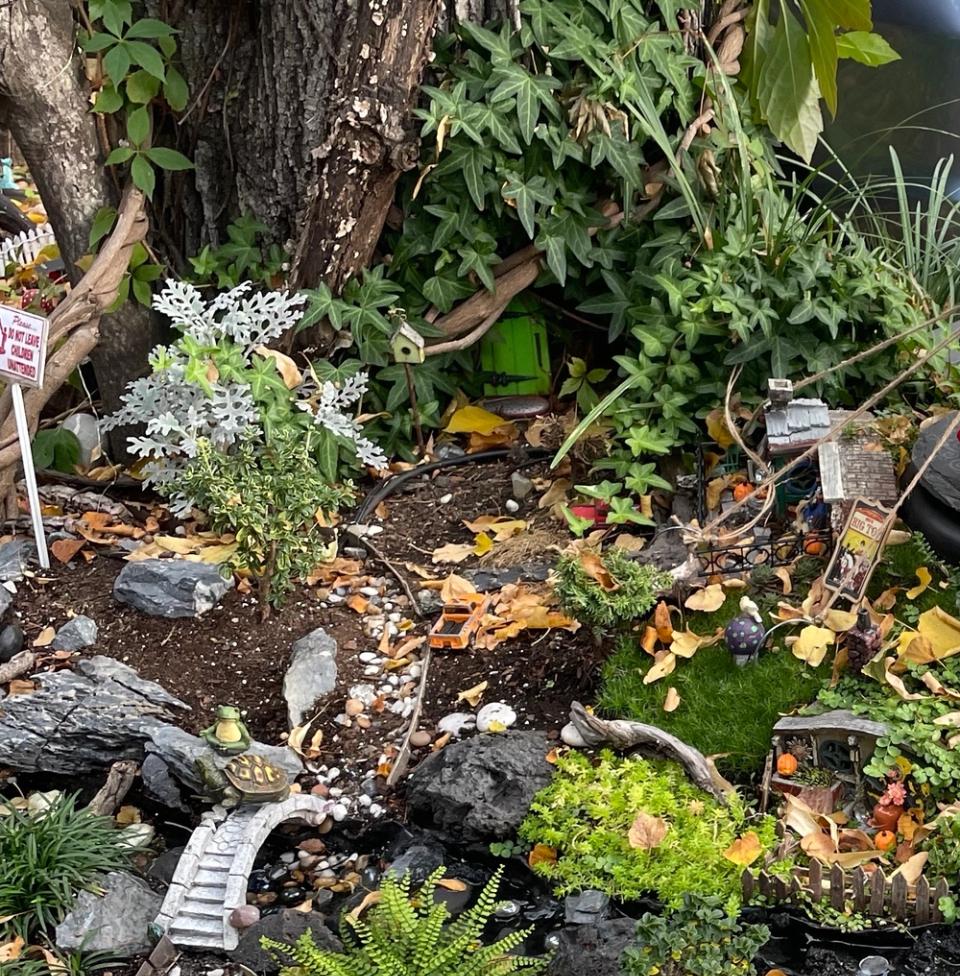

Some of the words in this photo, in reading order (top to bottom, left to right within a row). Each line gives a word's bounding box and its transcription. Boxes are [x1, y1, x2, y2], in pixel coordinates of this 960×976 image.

[15, 329, 26, 343] NOT
[25, 332, 40, 348] LEAVE
[11, 344, 33, 361] CHILDREN
[7, 358, 36, 378] UNATTENDED
